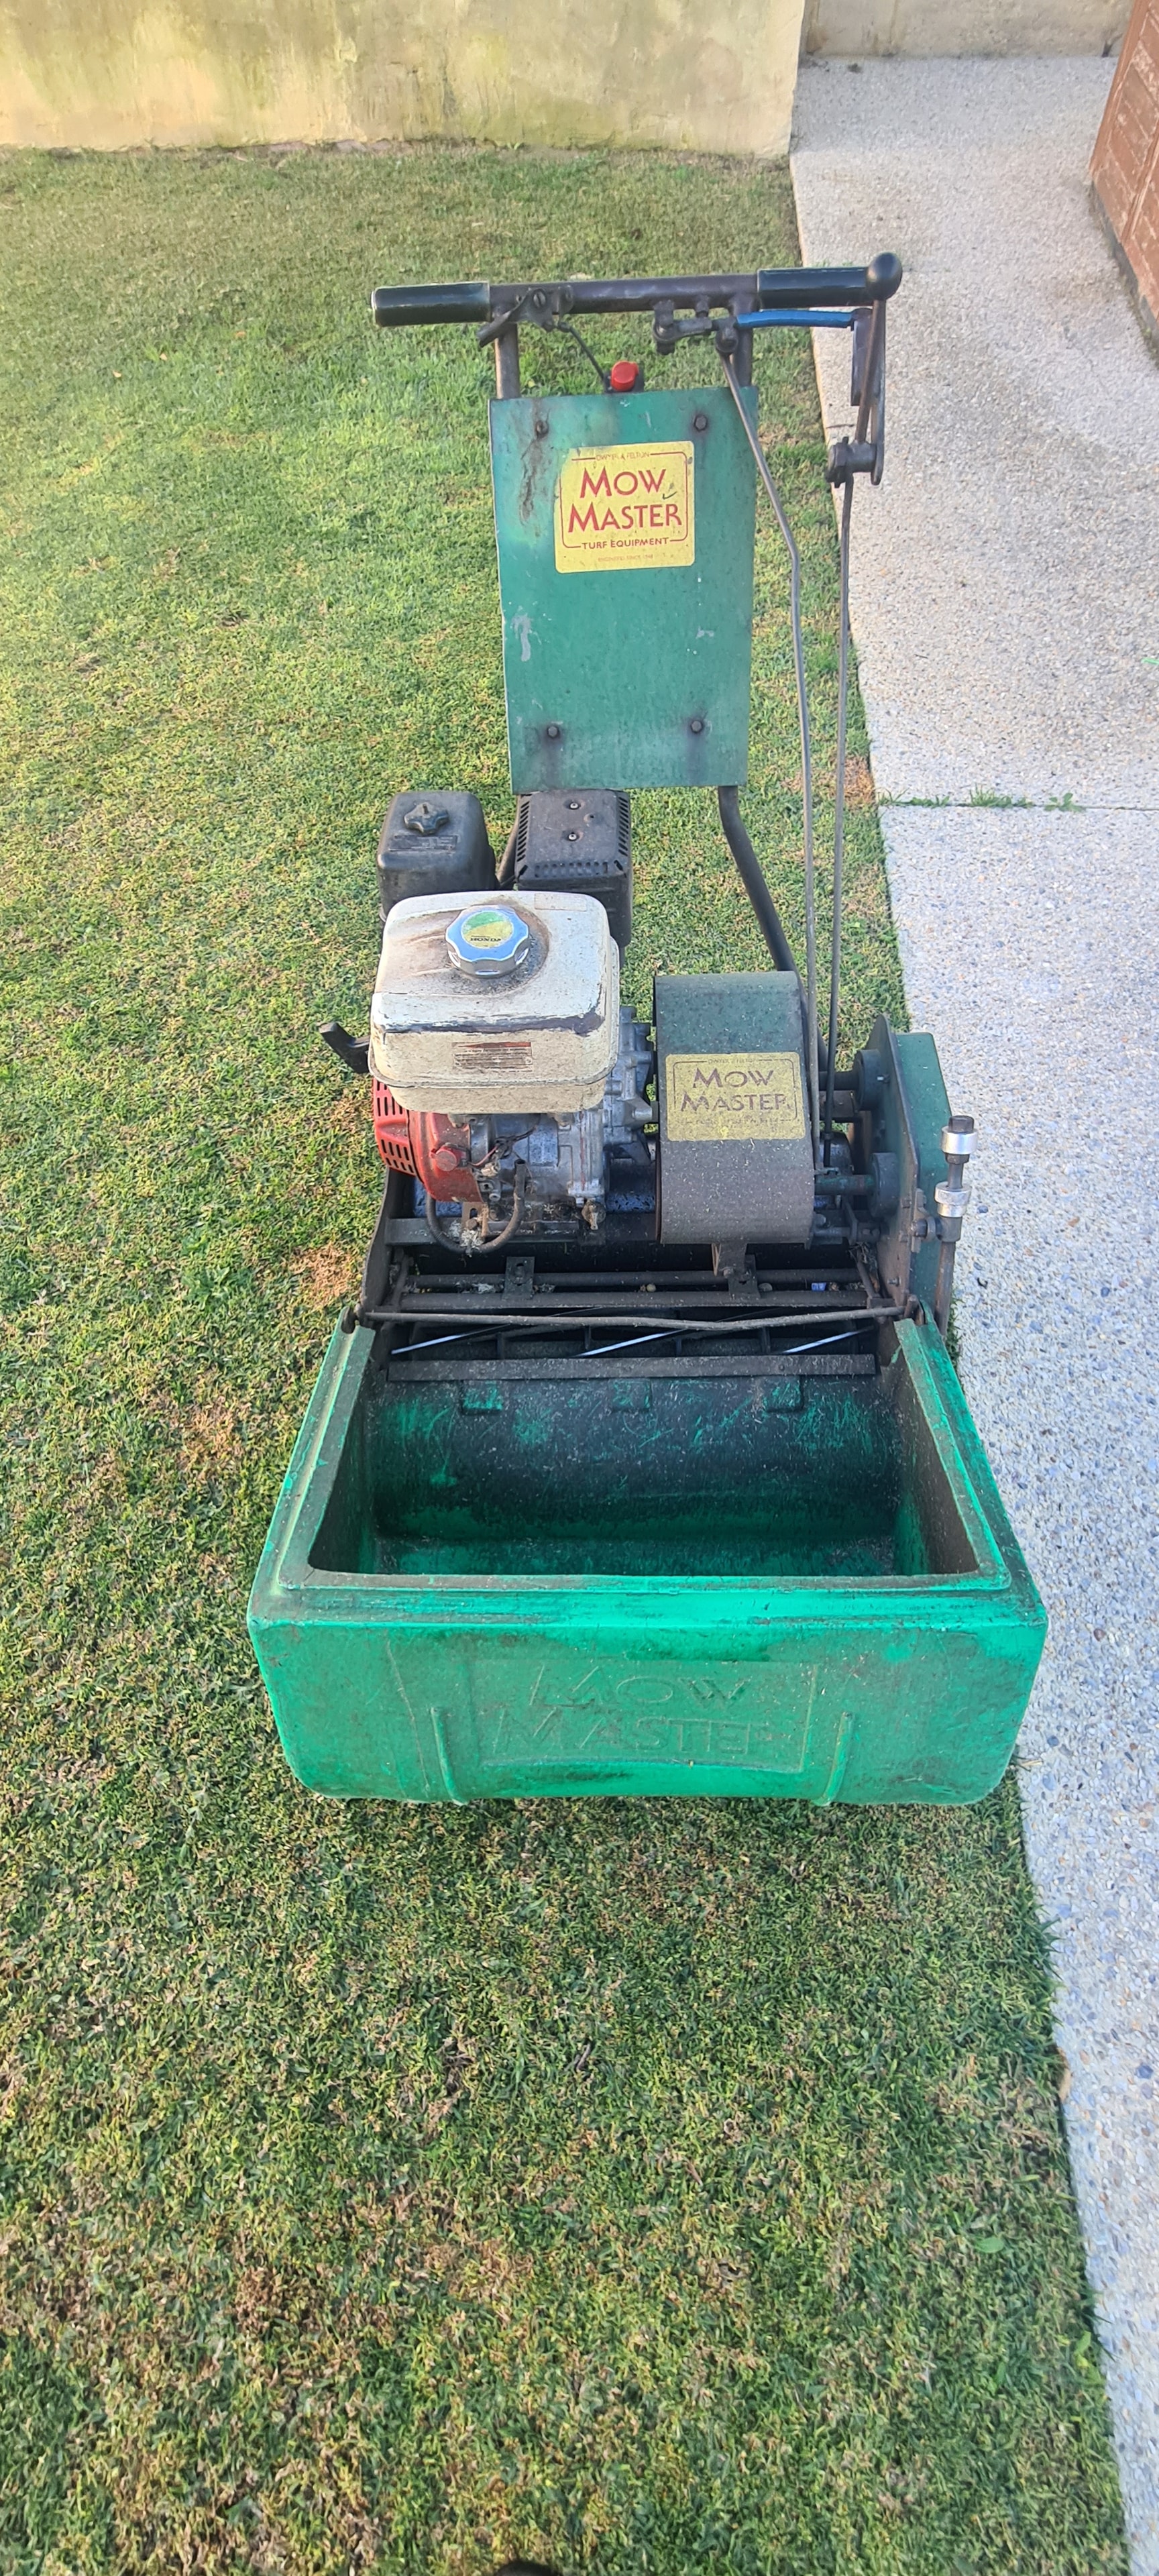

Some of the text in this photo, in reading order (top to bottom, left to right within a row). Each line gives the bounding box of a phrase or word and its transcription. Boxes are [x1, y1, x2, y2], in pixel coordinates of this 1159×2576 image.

[580, 466, 667, 498] MOW
[568, 501, 682, 533] MASTER
[582, 537, 669, 550] TURF EQUIPMENT
[692, 1067, 774, 1088] MOW
[680, 1091, 791, 1112] MASTER
[529, 1664, 751, 1708] MOW
